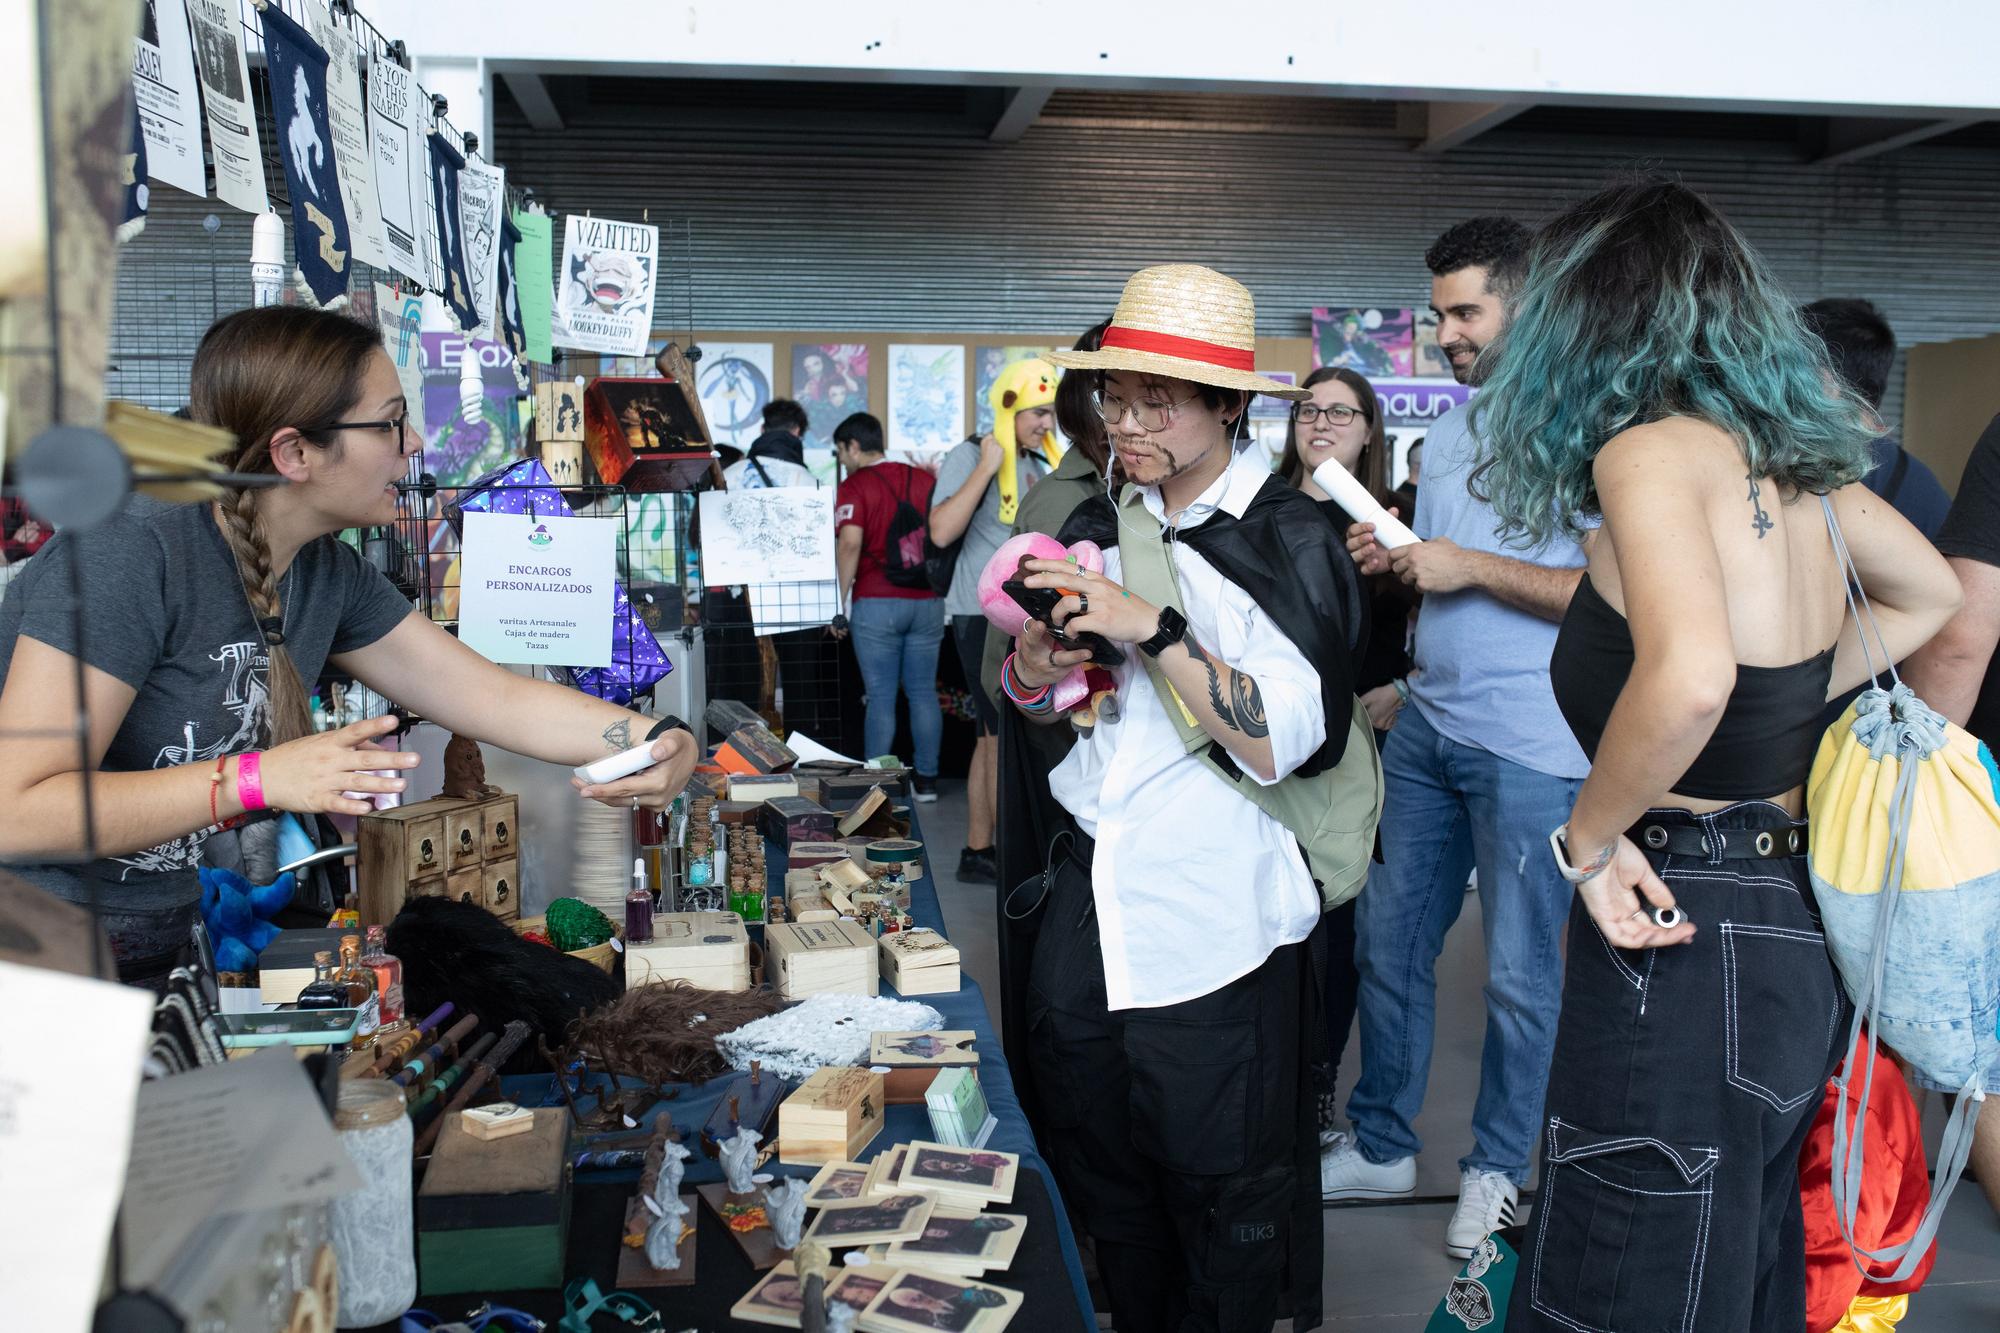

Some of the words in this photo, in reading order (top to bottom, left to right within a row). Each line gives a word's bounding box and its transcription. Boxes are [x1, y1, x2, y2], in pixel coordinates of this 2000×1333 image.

[385, 65, 408, 90] YOU
[384, 81, 408, 108] THIS
[374, 93, 405, 122] ZARD?
[577, 220, 651, 254] WANTED
[508, 564, 572, 577] ENCARGOS
[486, 580, 593, 595] PERSONALIZADOS
[499, 617, 528, 627] varitas
[529, 618, 577, 628] Artesanales
[504, 629, 526, 639] Cajas
[528, 629, 538, 638] de
[539, 630, 570, 639] madera
[526, 641, 549, 650] Tazas
